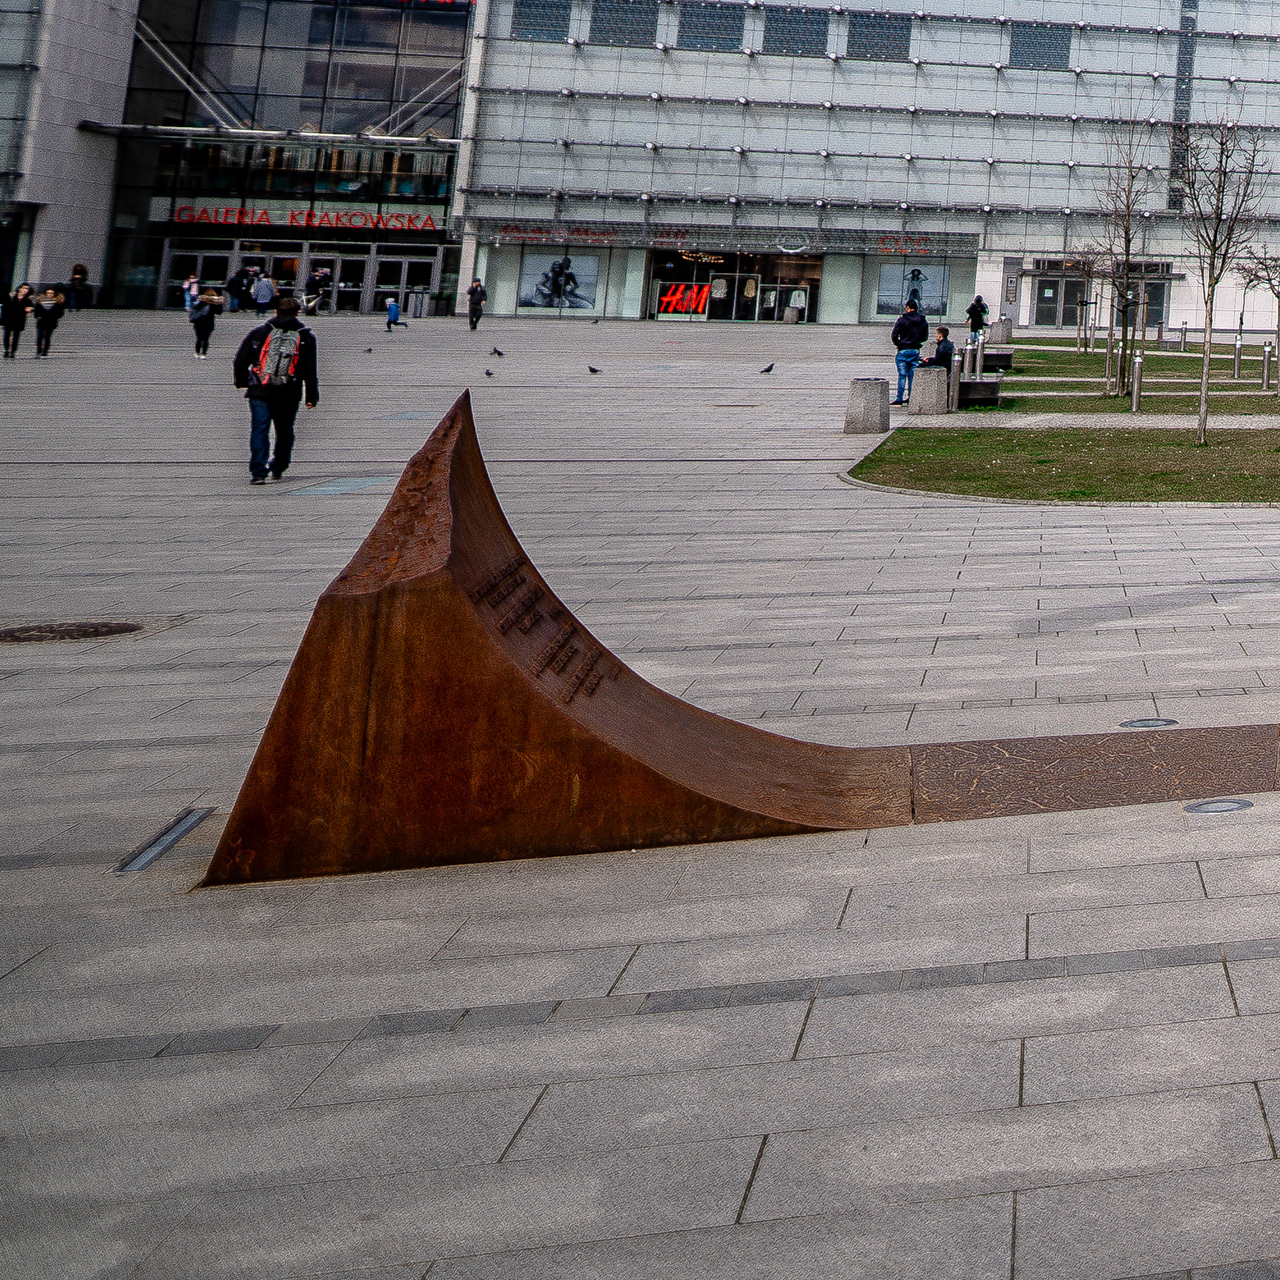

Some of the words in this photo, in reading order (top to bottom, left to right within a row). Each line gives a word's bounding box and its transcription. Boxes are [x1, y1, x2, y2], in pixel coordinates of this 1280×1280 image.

[174, 205, 271, 226] GALERIA
[288, 208, 436, 231] KRAKOWSKA
[660, 283, 711, 314] H&M
